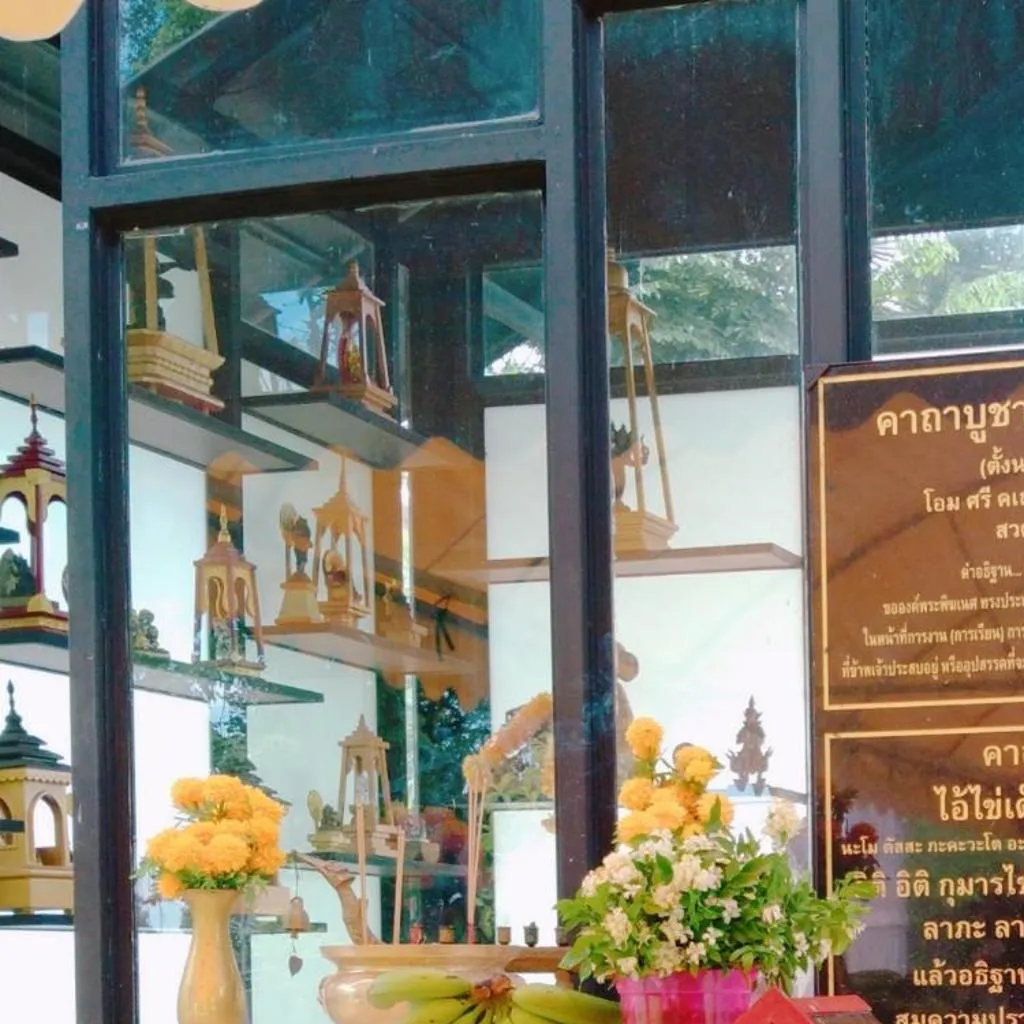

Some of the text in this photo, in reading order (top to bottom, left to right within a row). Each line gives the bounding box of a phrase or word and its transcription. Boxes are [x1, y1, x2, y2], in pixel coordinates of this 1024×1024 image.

[923, 488, 961, 514] โอม
[966, 485, 991, 510] ศรี
[841, 836, 878, 857] นะโม
[895, 869, 931, 898] อิติ
[922, 919, 987, 941] ลาภะ
